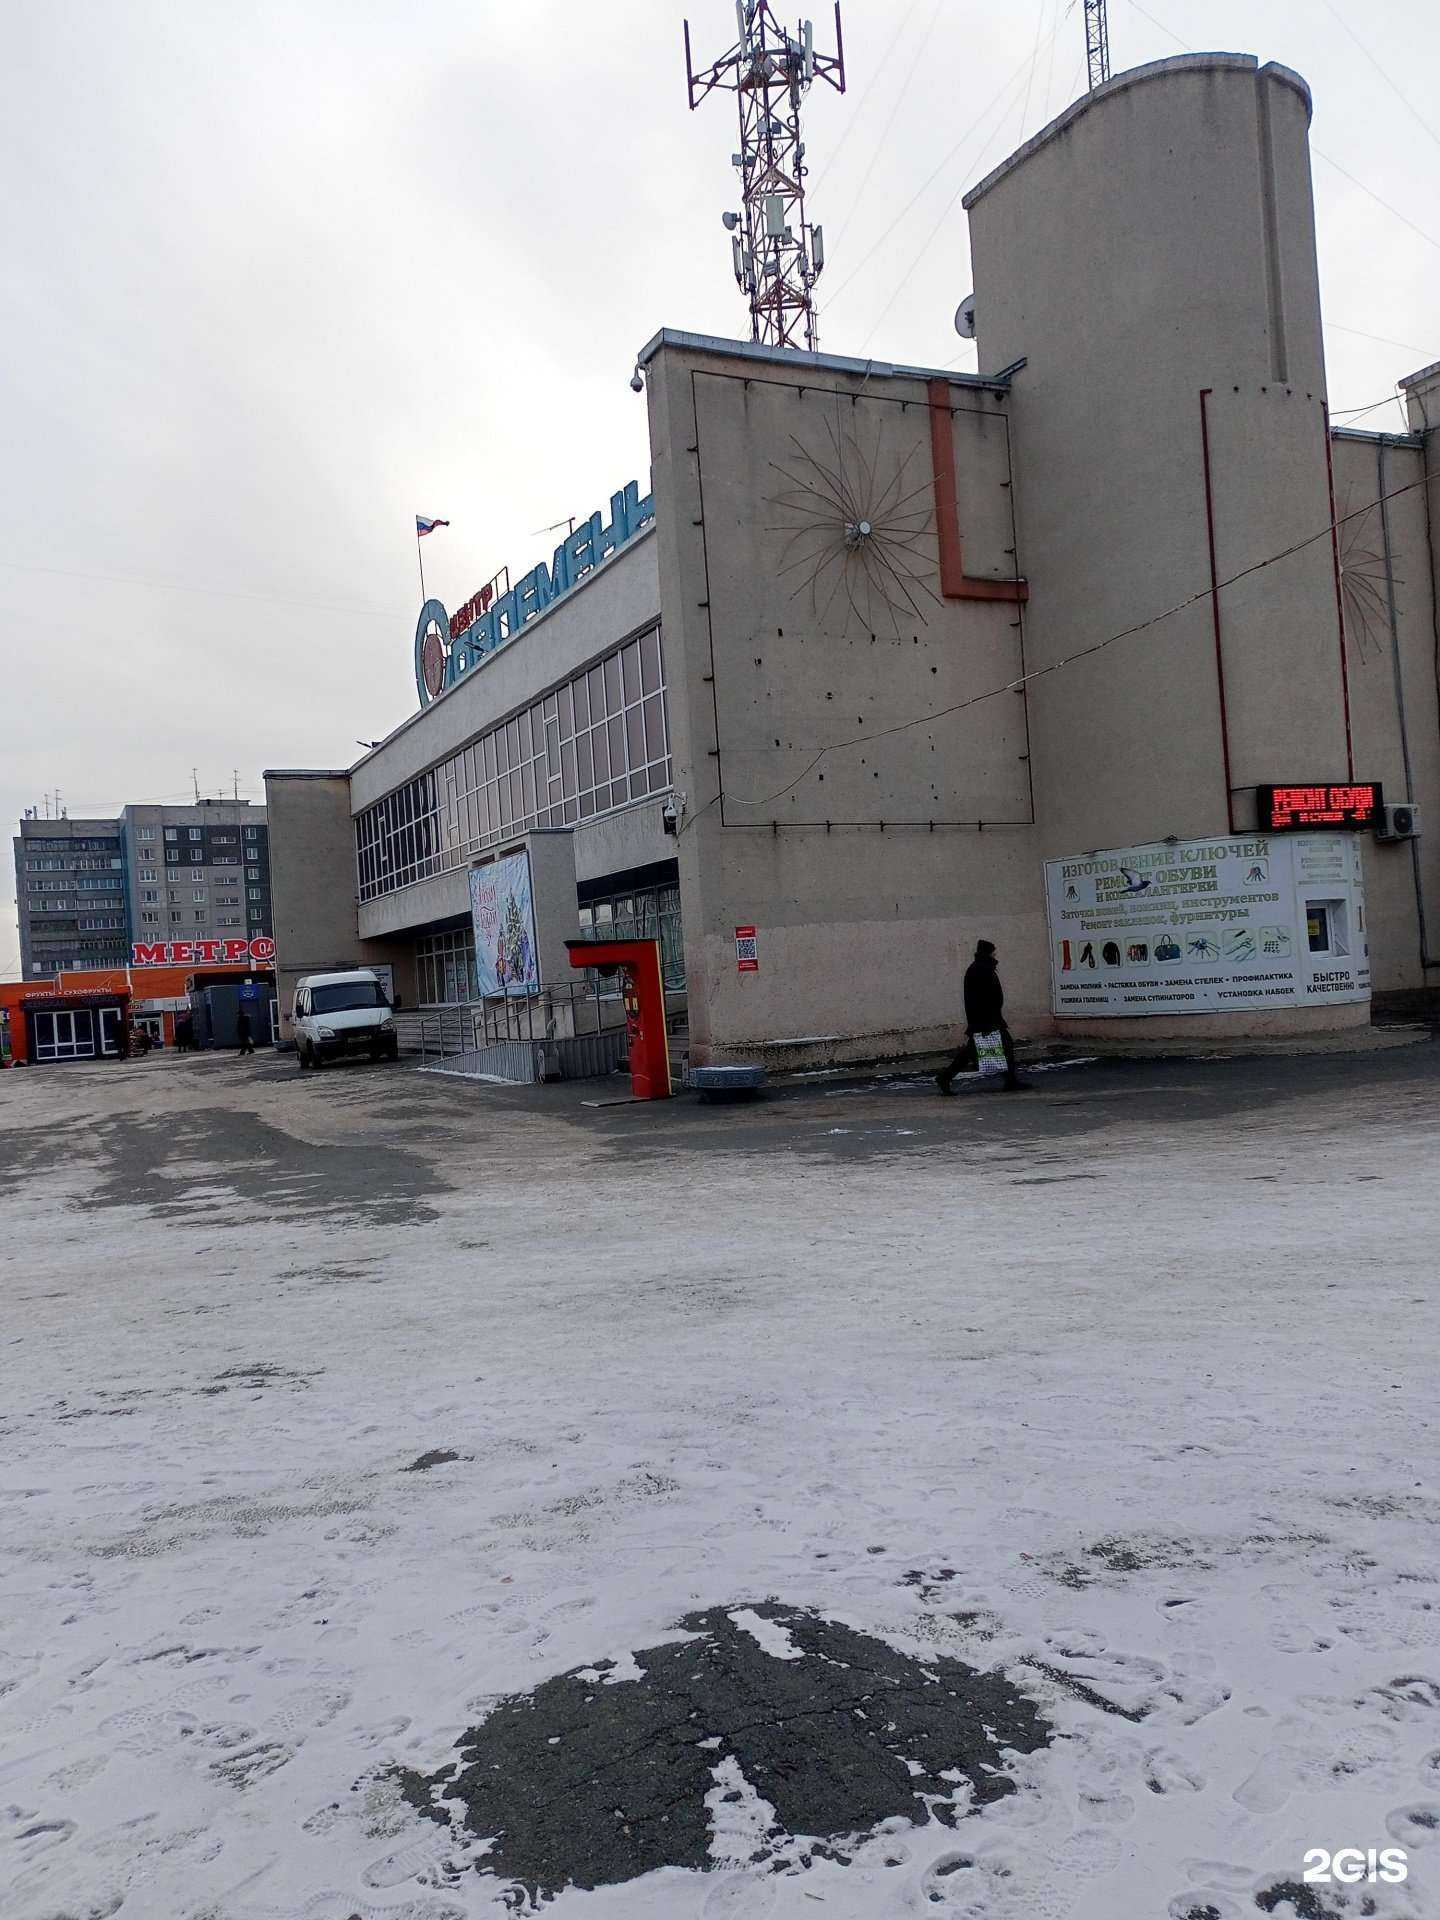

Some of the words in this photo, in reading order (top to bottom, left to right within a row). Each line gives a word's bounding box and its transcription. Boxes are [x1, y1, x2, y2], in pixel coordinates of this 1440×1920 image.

[1061, 852, 1175, 879] ИЗГОТОВЛЕНИЕ
[1180, 839, 1271, 864] КЛЮЧЕЙ
[1155, 864, 1218, 884] ОБУВИ
[132, 936, 276, 966] МЕТРО
[1164, 977, 1193, 988] ЗАМЕНА
[1194, 975, 1224, 986] СТЕЛЕК
[1232, 972, 1294, 984] ПРОФИЛАКТИКА
[1312, 970, 1350, 983] БЫСТРО
[1216, 988, 1263, 999] УСТАНОВКА
[1264, 986, 1295, 997] НАБОЕК
[1306, 981, 1355, 994] КАЧЕСТВЕННО
